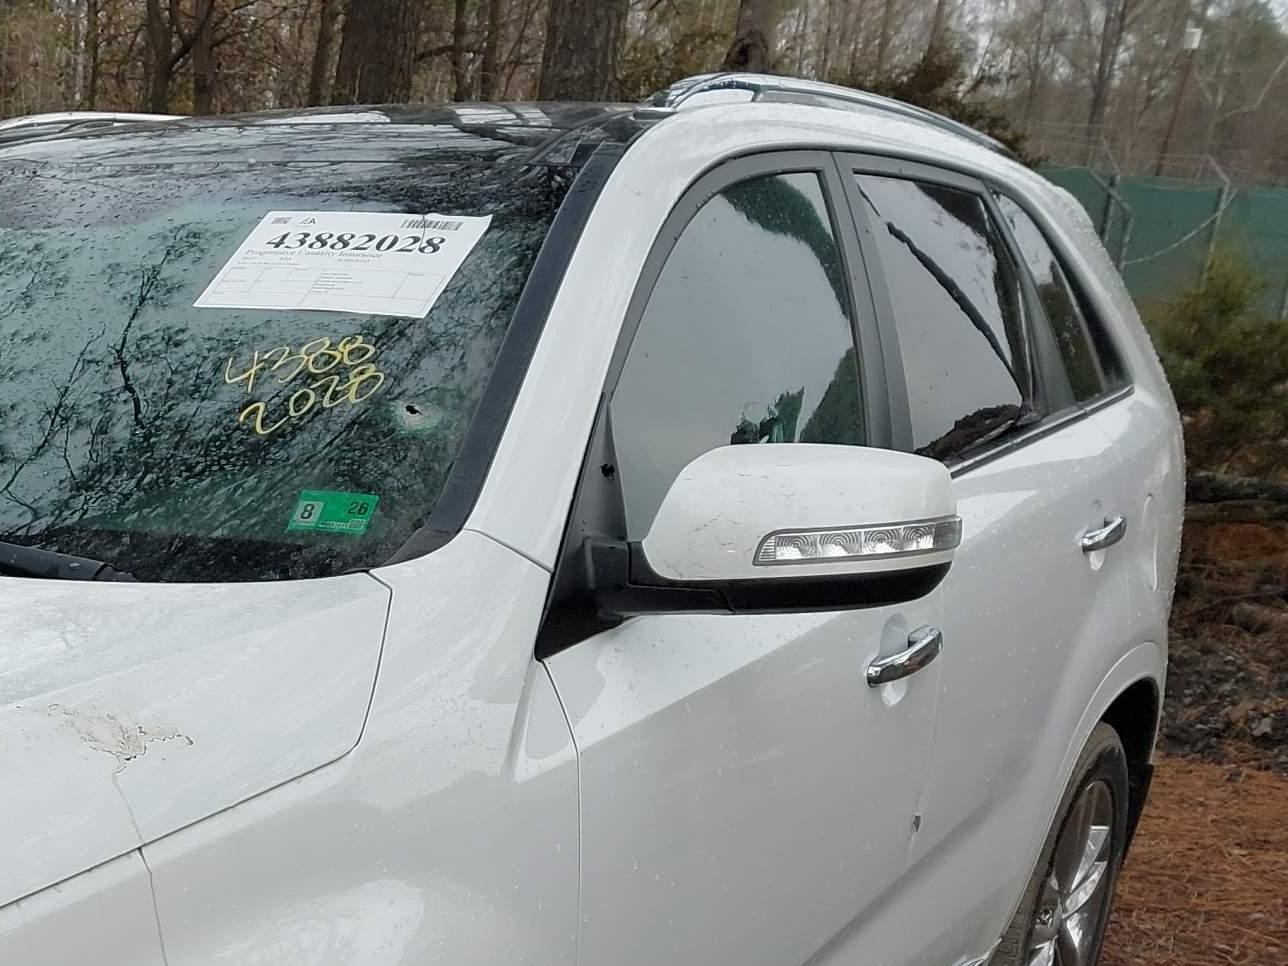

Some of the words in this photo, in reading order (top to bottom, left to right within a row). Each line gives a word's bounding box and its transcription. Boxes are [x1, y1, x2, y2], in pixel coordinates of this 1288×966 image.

[246, 249, 296, 257] Progressive
[338, 251, 383, 259] Insurance
[266, 231, 446, 254] 43882028
[225, 335, 375, 393] 4388
[239, 364, 384, 435] 2028
[300, 503, 316, 519] 8
[347, 501, 370, 515] 26
